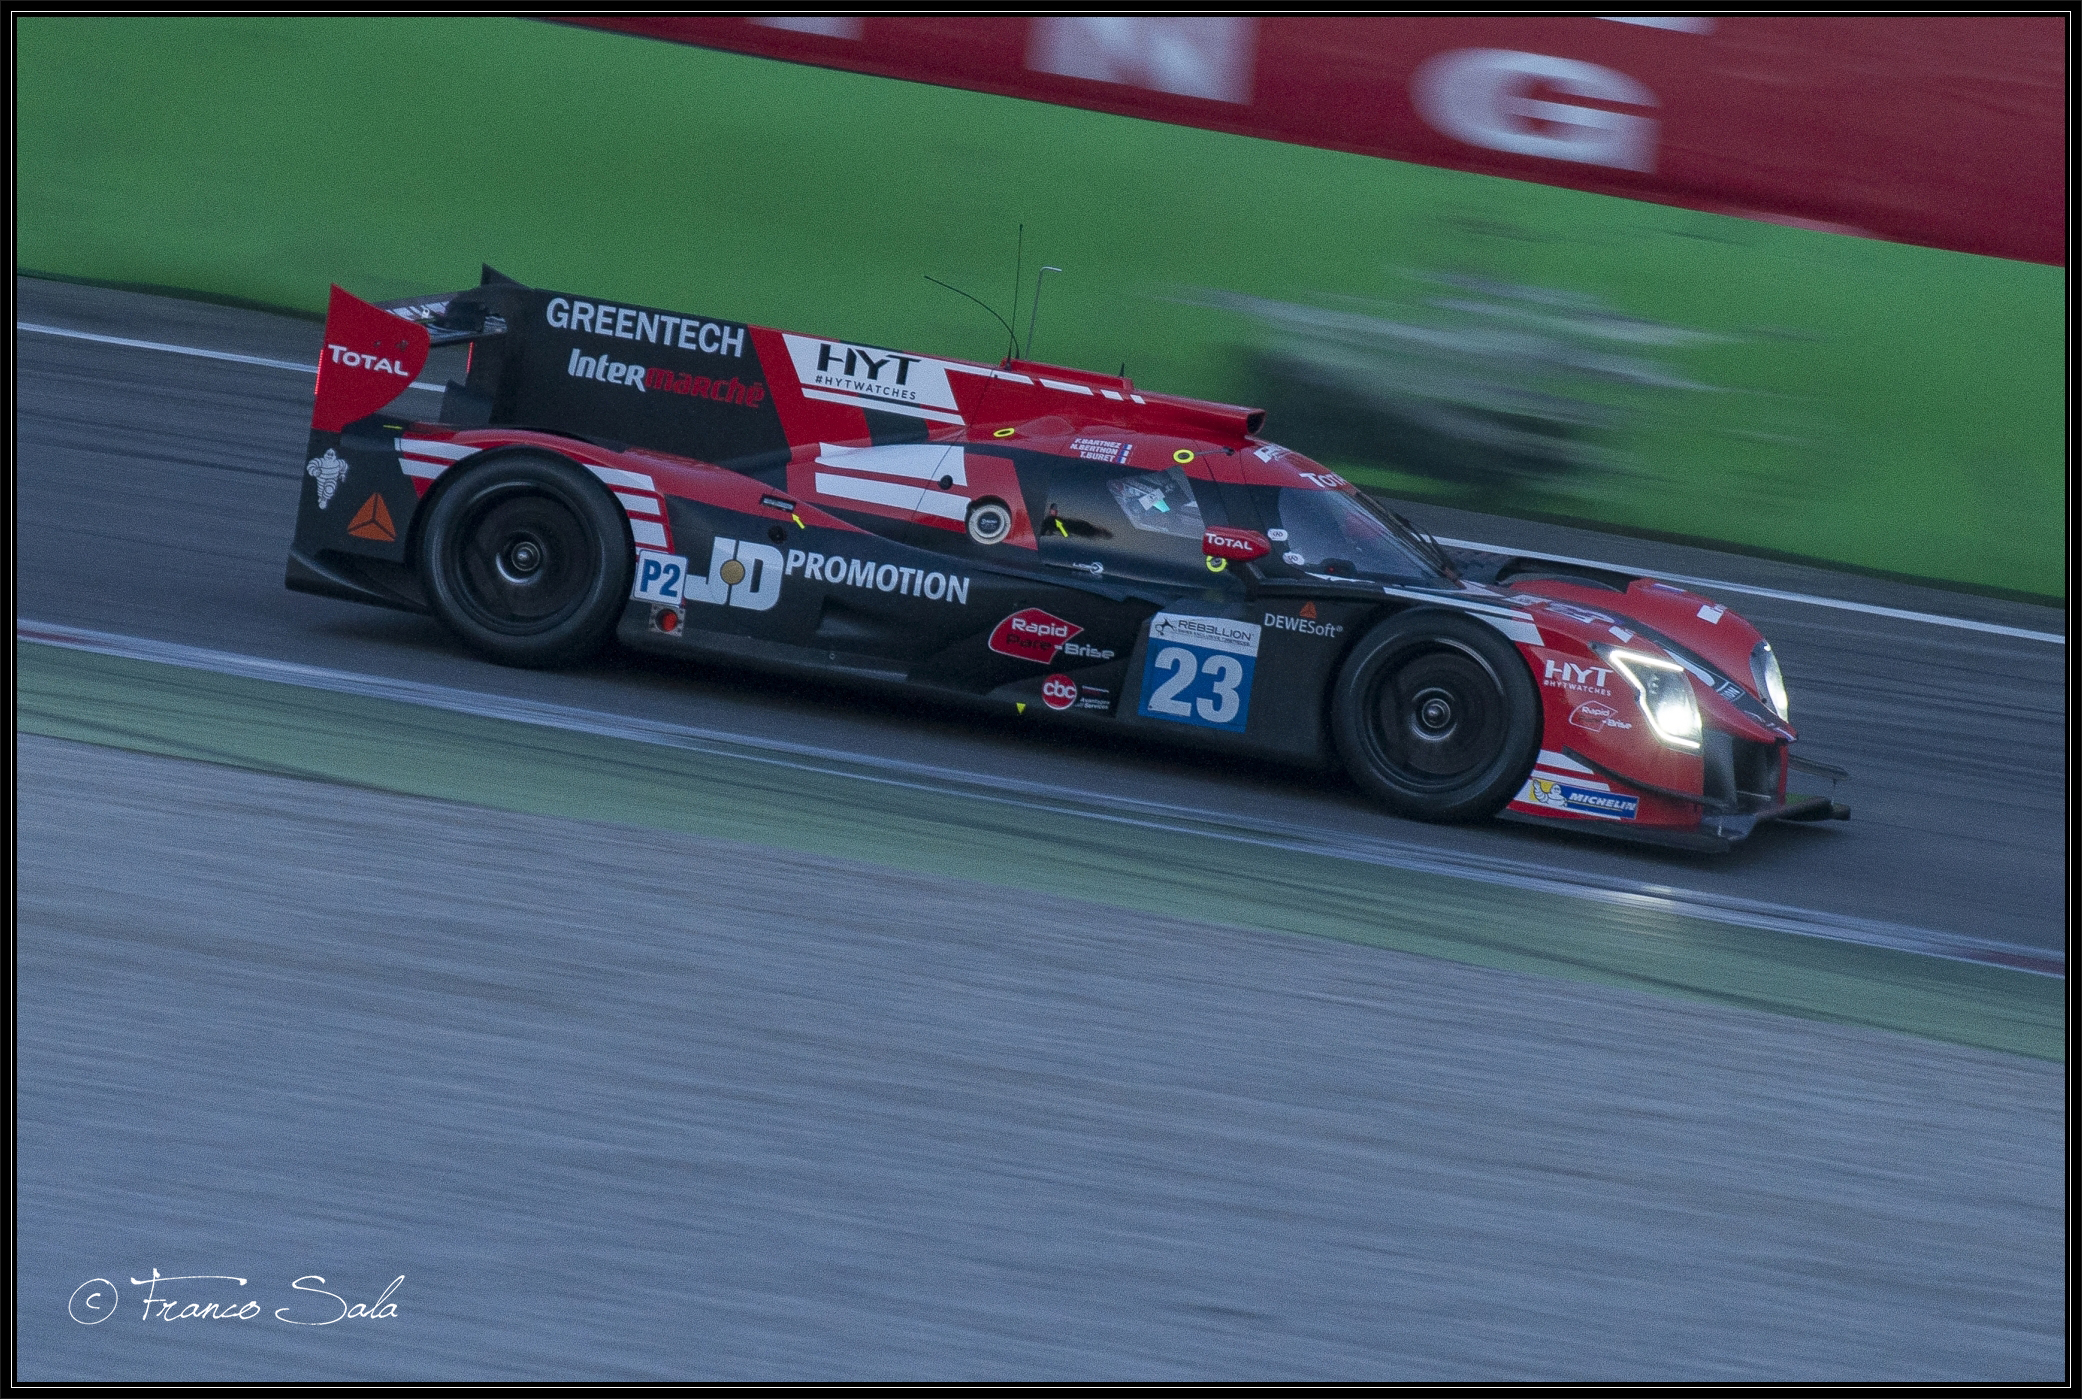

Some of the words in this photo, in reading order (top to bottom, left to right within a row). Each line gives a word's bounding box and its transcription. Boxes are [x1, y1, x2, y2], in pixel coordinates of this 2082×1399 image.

[546, 297, 745, 358] GREENTECH
[328, 344, 409, 377] TOTAL
[817, 343, 922, 386] HYT
[815, 375, 917, 400] #HYTWATCHES
[1205, 532, 1253, 551] TOTAL
[639, 558, 682, 598] P2
[785, 549, 970, 605] PROMOTION
[1011, 617, 1068, 637] Rapid
[1147, 646, 1243, 723] 23
[1544, 659, 1614, 688] HYT
[1043, 680, 1077, 699] cbc
[1569, 792, 1637, 811] MICHELIN
